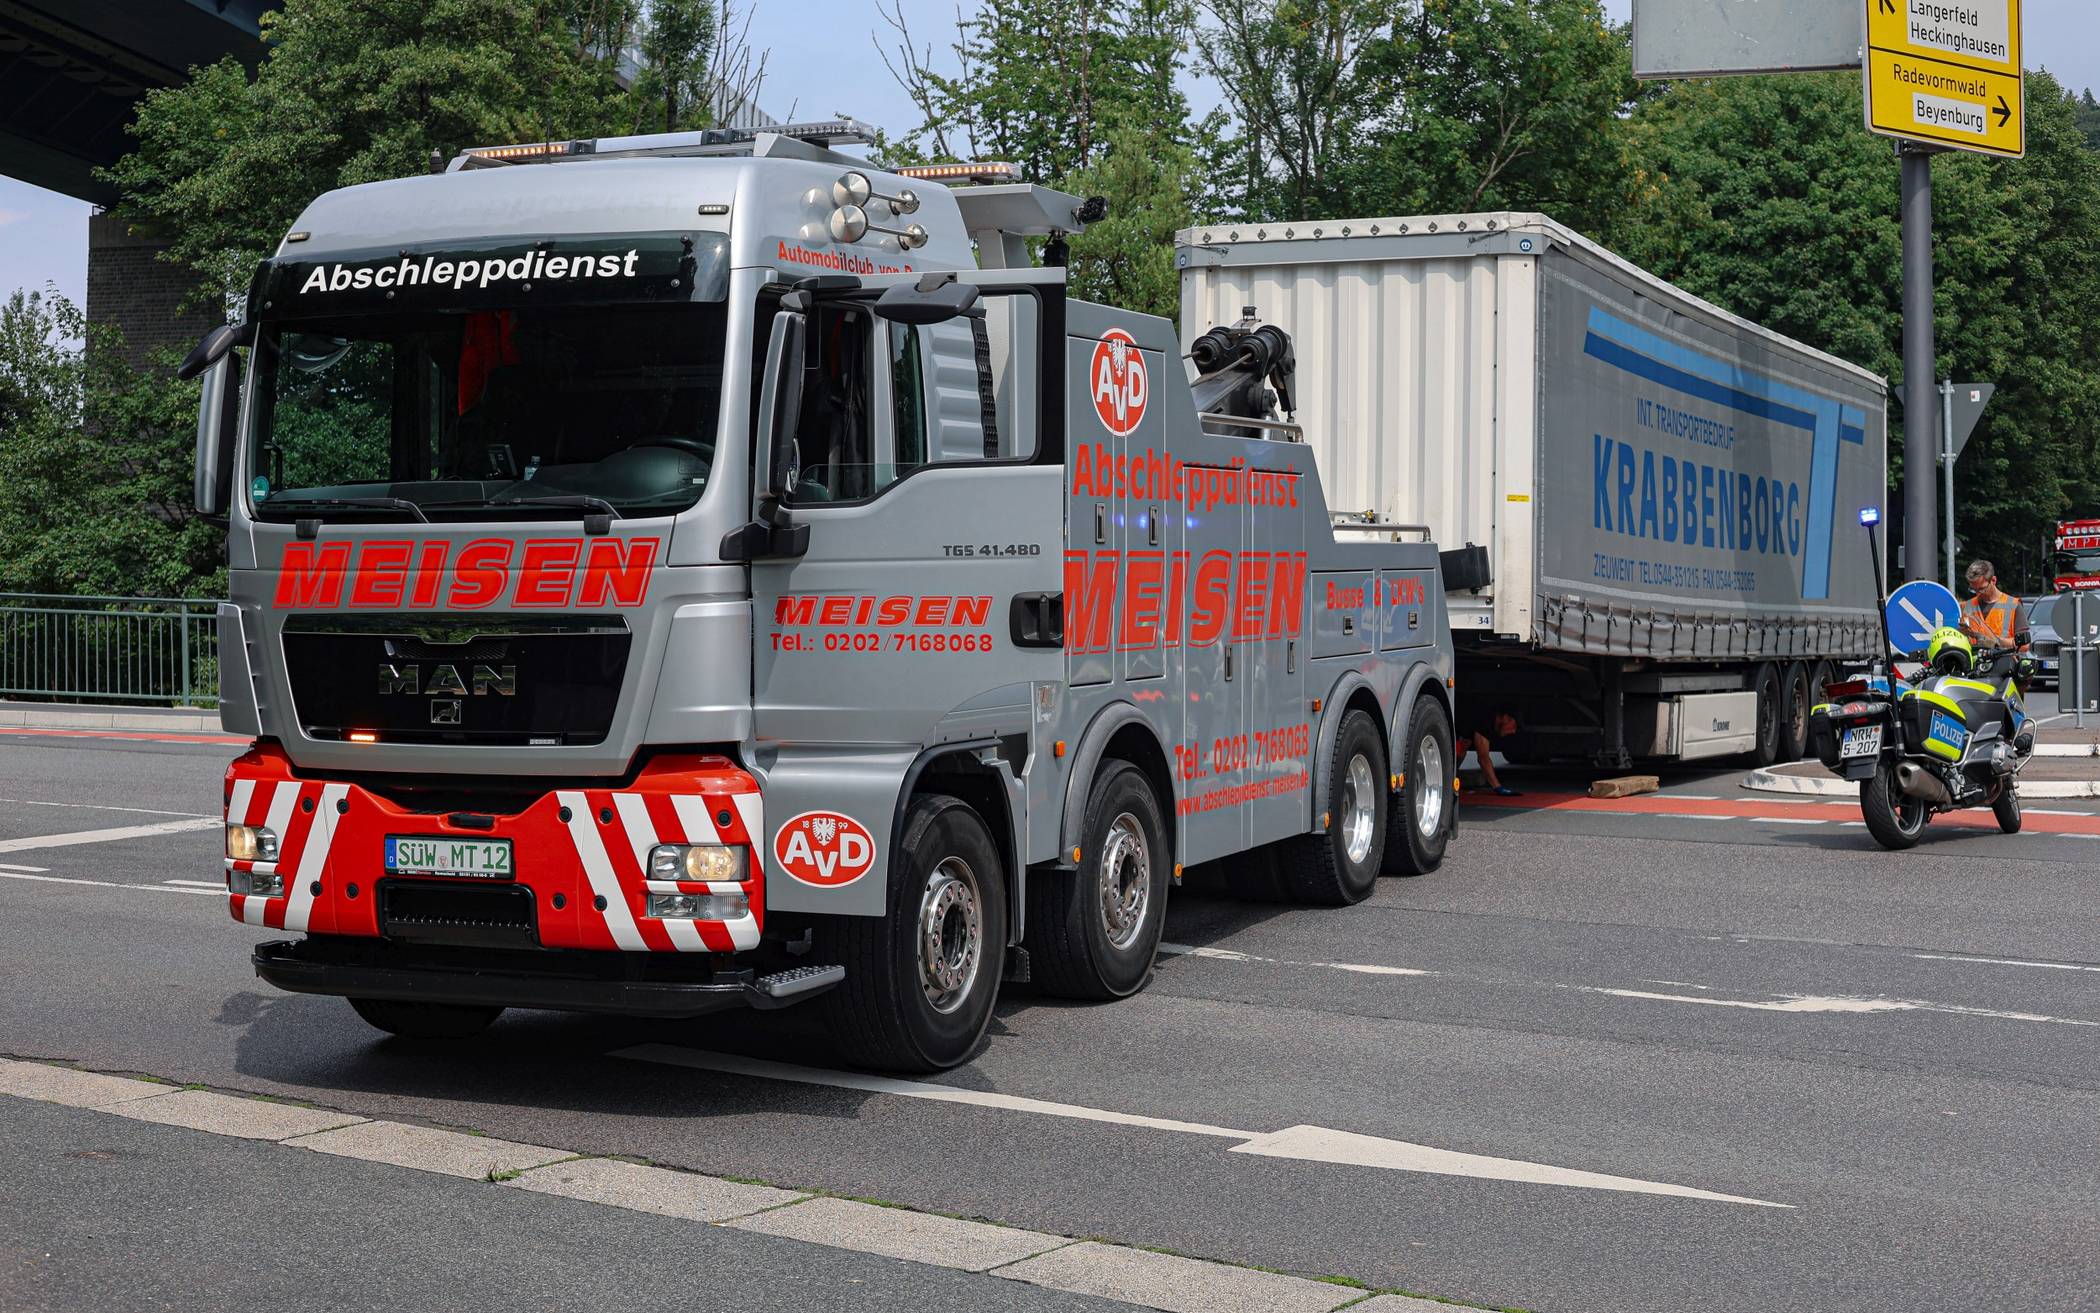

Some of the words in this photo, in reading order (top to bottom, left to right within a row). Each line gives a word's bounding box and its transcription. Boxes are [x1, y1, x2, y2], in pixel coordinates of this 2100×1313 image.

[1911, 0, 1978, 27] Langerfeld
[1911, 22, 2005, 57] Heckinghausen
[1893, 64, 1986, 97] Radevormwald
[1917, 100, 1983, 131] Beyenburg
[300, 249, 639, 294] Abschleppdienst
[778, 241, 874, 274] Automobilclub
[1637, 397, 1653, 428] INT.
[1656, 404, 1734, 450] TRANSPORTBEDRIJF
[1072, 443, 1298, 512] Abschleppdienst
[1594, 434, 1800, 557] KRABBENBORG
[943, 544, 974, 557] TGS
[979, 544, 1041, 556] 41.480
[272, 537, 661, 610] MEISEN
[1594, 552, 1635, 582] ZIEUWENT
[1064, 549, 1307, 656] MEISEN
[1326, 581, 1364, 610] Busse
[1374, 578, 1381, 607] &
[770, 595, 993, 627] MEISEN
[1478, 616, 1489, 625] 34
[770, 633, 814, 651] Tel.:
[378, 664, 516, 695] MAN
[1850, 727, 1873, 742] NRW
[1175, 742, 1207, 784] Tel.:
[398, 842, 437, 867] SÜW
[451, 844, 478, 868] MT
[482, 846, 507, 870] 12
